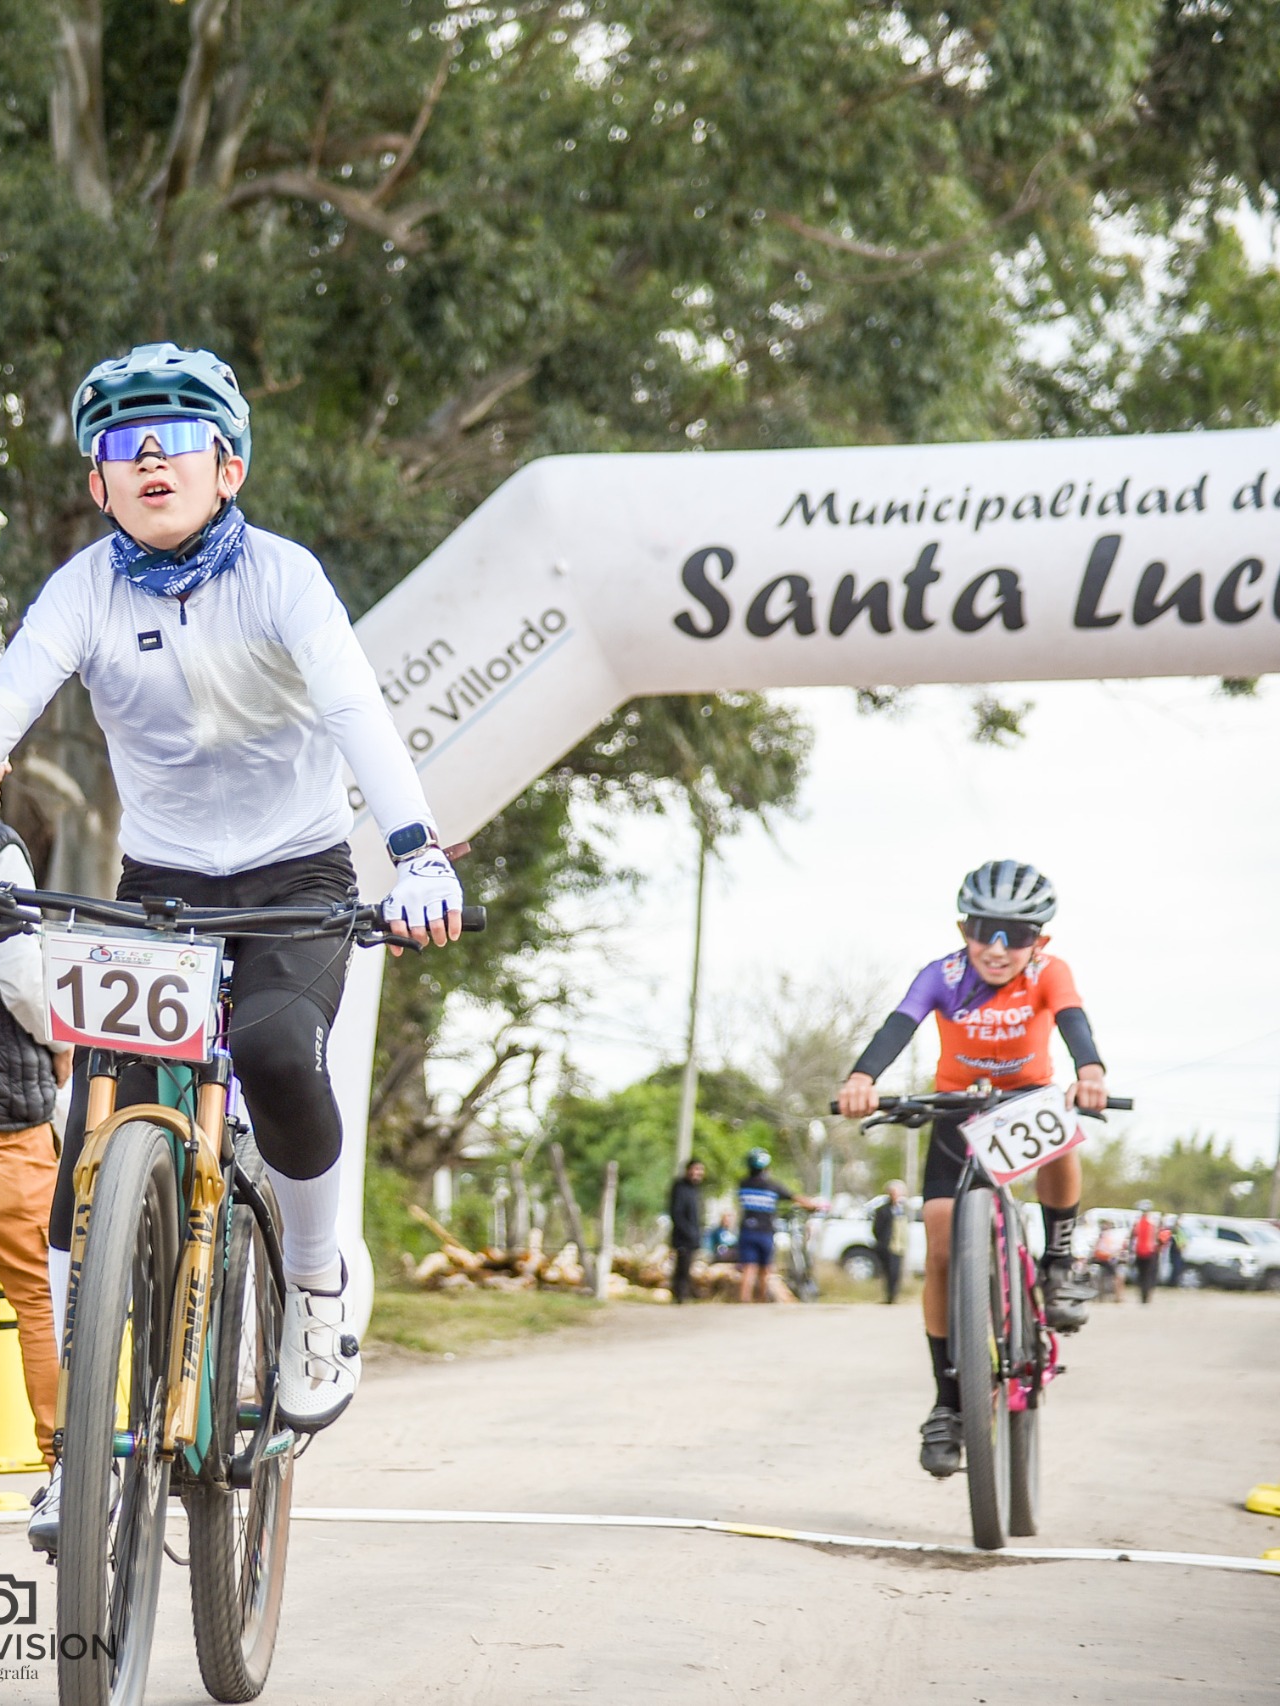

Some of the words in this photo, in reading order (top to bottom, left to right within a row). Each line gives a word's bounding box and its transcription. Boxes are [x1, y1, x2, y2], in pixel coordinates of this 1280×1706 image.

[779, 475, 1208, 531] Municipalidad
[1232, 470, 1280, 511] d
[673, 542, 1027, 641] Santa
[1073, 534, 1280, 629] Luc
[381, 638, 456, 706] tión
[427, 608, 567, 722] Villordo
[56, 965, 190, 1042] 126
[952, 1005, 1035, 1025] CASTOR
[965, 1024, 1027, 1040] TEAM
[989, 1109, 1066, 1169] 139
[179, 1266, 208, 1383] TANKE
